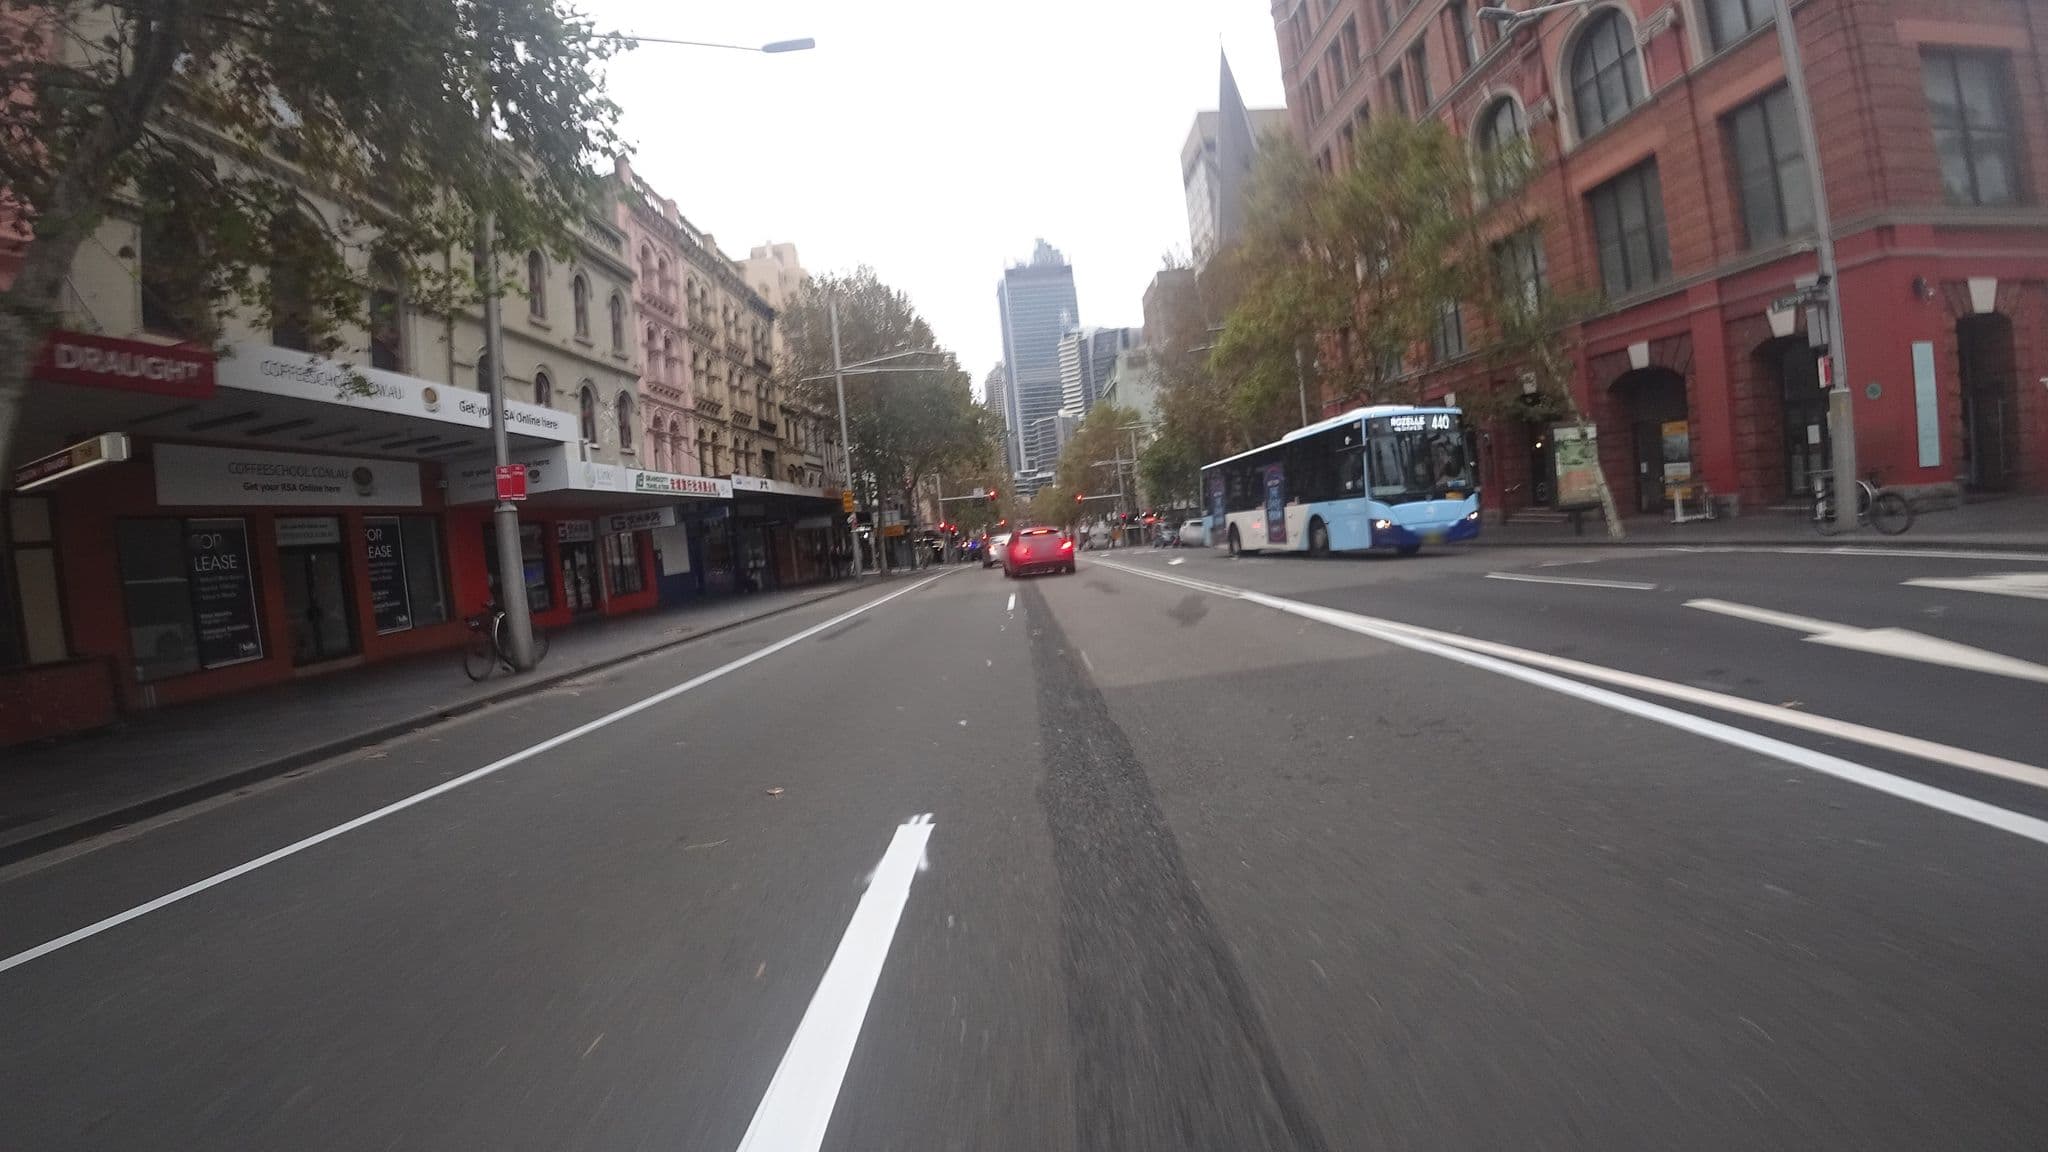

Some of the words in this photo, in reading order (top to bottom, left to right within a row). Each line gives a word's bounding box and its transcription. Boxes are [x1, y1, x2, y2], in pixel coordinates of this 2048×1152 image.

[54, 343, 202, 382] DRAUGHT
[460, 401, 475, 415] Get
[503, 409, 515, 421] SA
[516, 412, 541, 426] Online
[541, 418, 558, 430] here
[1431, 413, 1450, 430] 440
[367, 528, 383, 542] OR
[367, 544, 392, 560] EASE
[193, 553, 238, 572] LEASE
